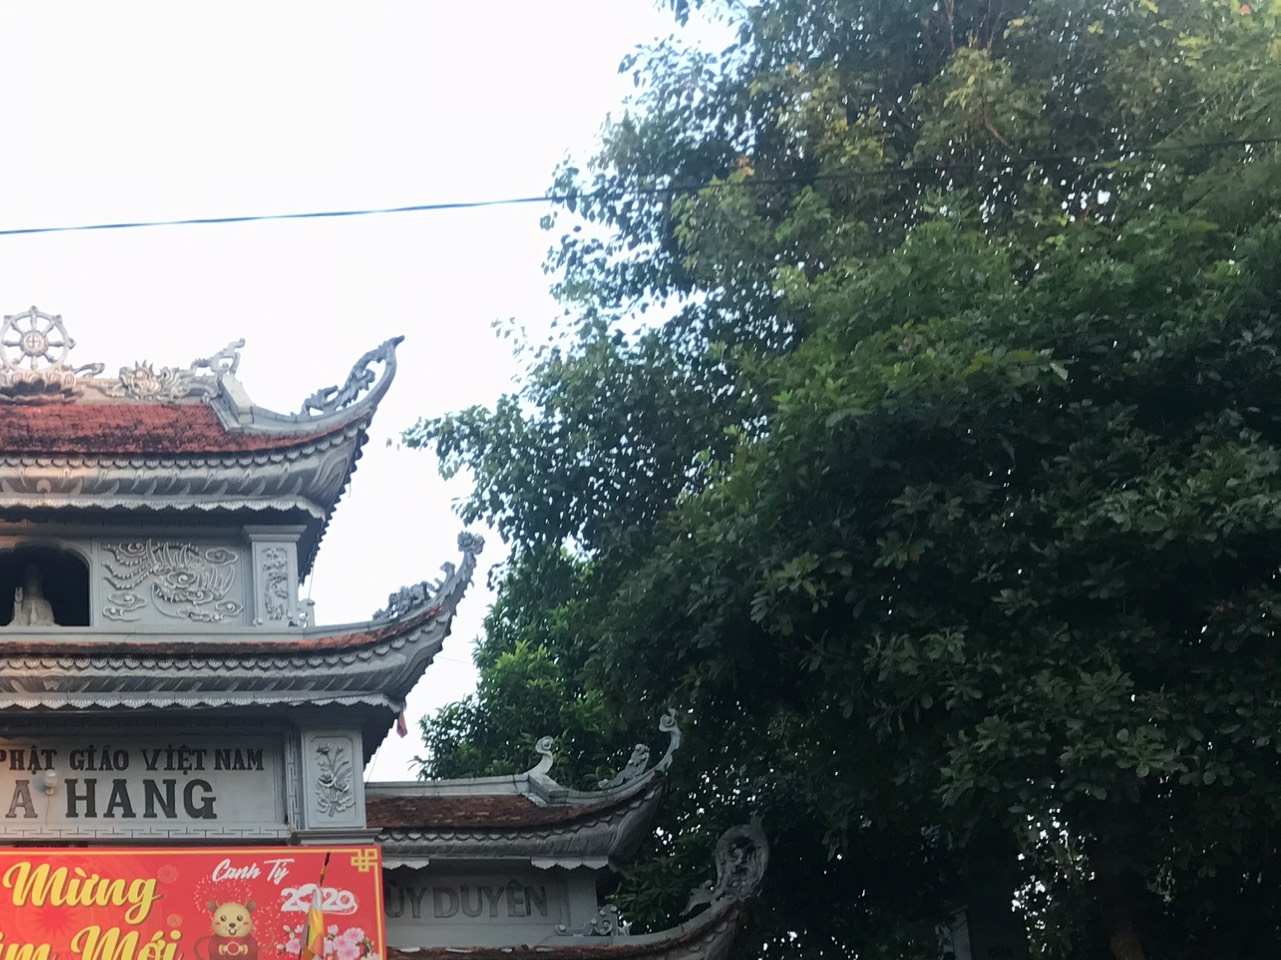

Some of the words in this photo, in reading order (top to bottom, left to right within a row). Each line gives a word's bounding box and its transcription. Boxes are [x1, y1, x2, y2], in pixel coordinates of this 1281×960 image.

[70, 745, 129, 771] GIÁO
[141, 745, 207, 775] VIỆT
[214, 749, 264, 771] NAM
[64, 778, 218, 819] HANG
[212, 858, 261, 882] Canh
[263, 858, 296, 886] Tý
[2, 861, 162, 925] Mừng
[280, 883, 359, 915] 2020
[433, 879, 549, 918] DUYÊN
